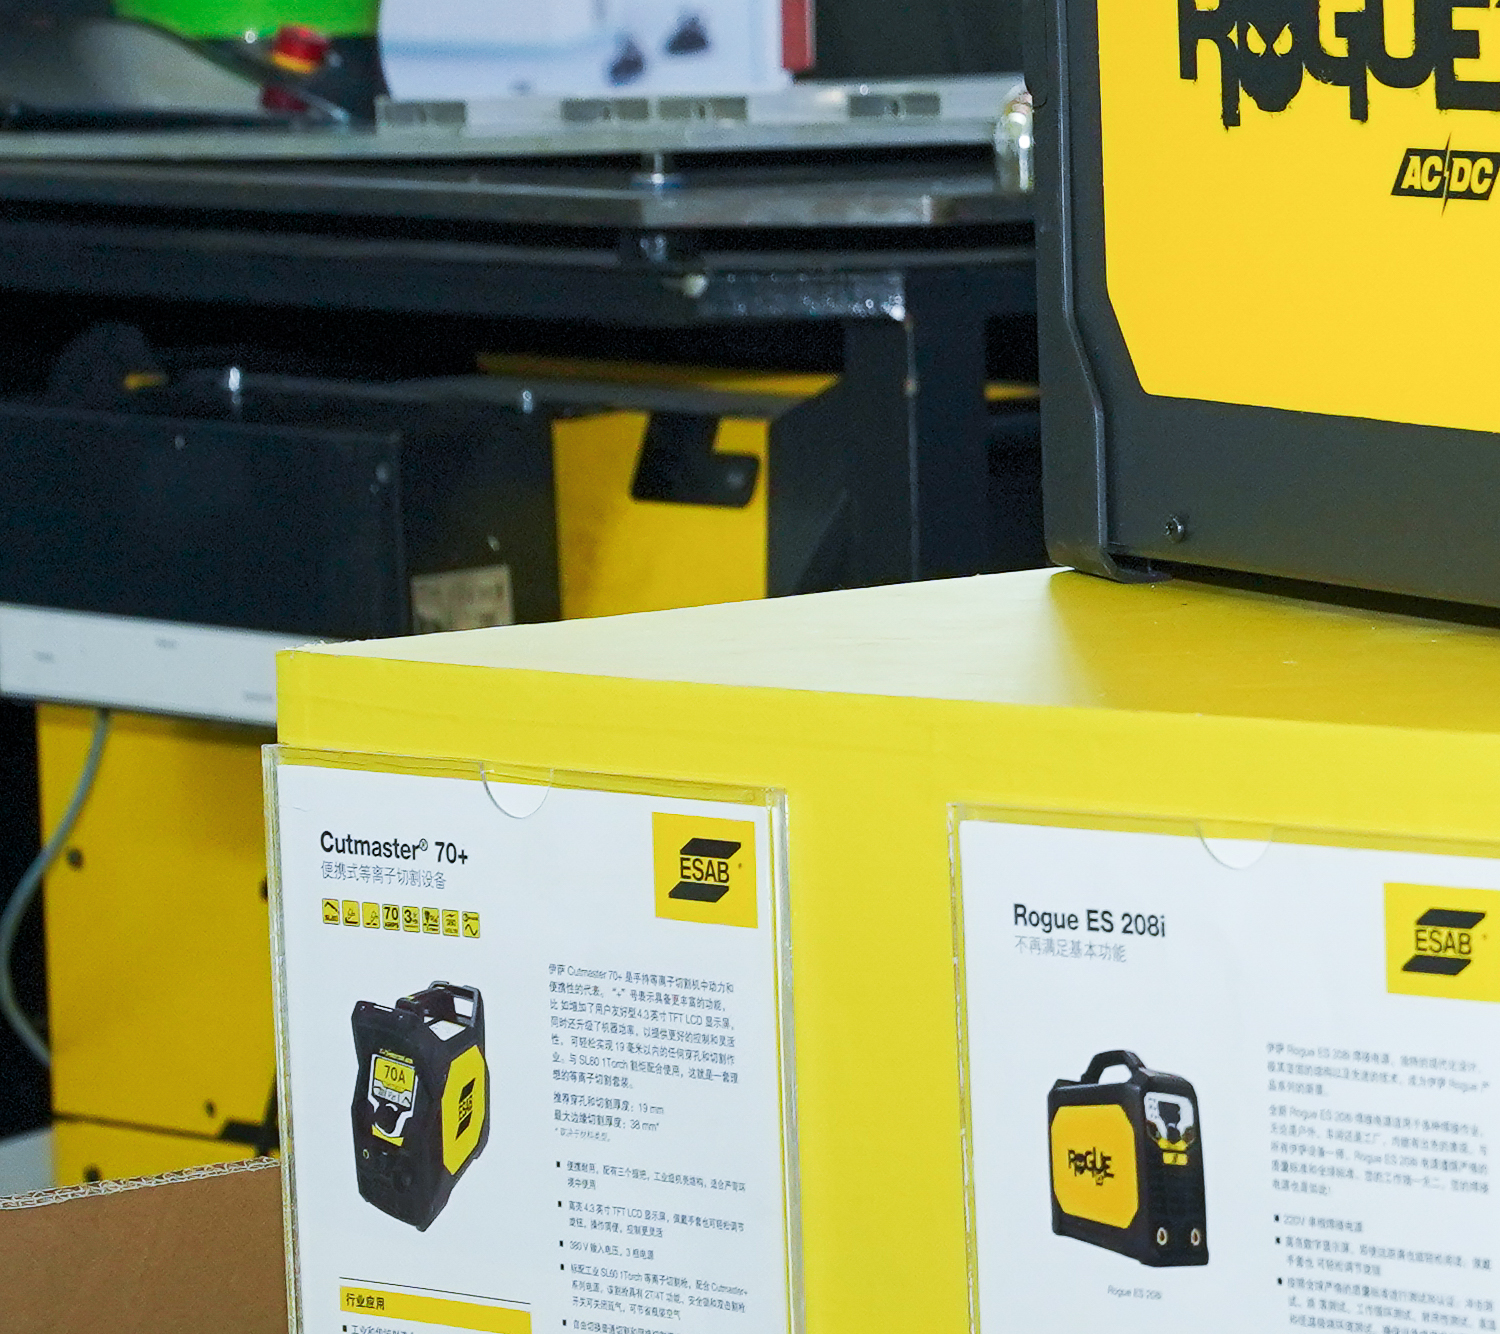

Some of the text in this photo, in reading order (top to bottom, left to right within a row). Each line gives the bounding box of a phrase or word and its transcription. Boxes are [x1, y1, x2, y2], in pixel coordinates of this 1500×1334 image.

[434, 840, 469, 865] 70+
[679, 858, 731, 885] ESAB
[383, 906, 400, 921] 70
[1013, 903, 1168, 939] Rogue ES 208i
[1414, 926, 1473, 956] ESAB
[345, 1292, 386, 1311] 行业应用
